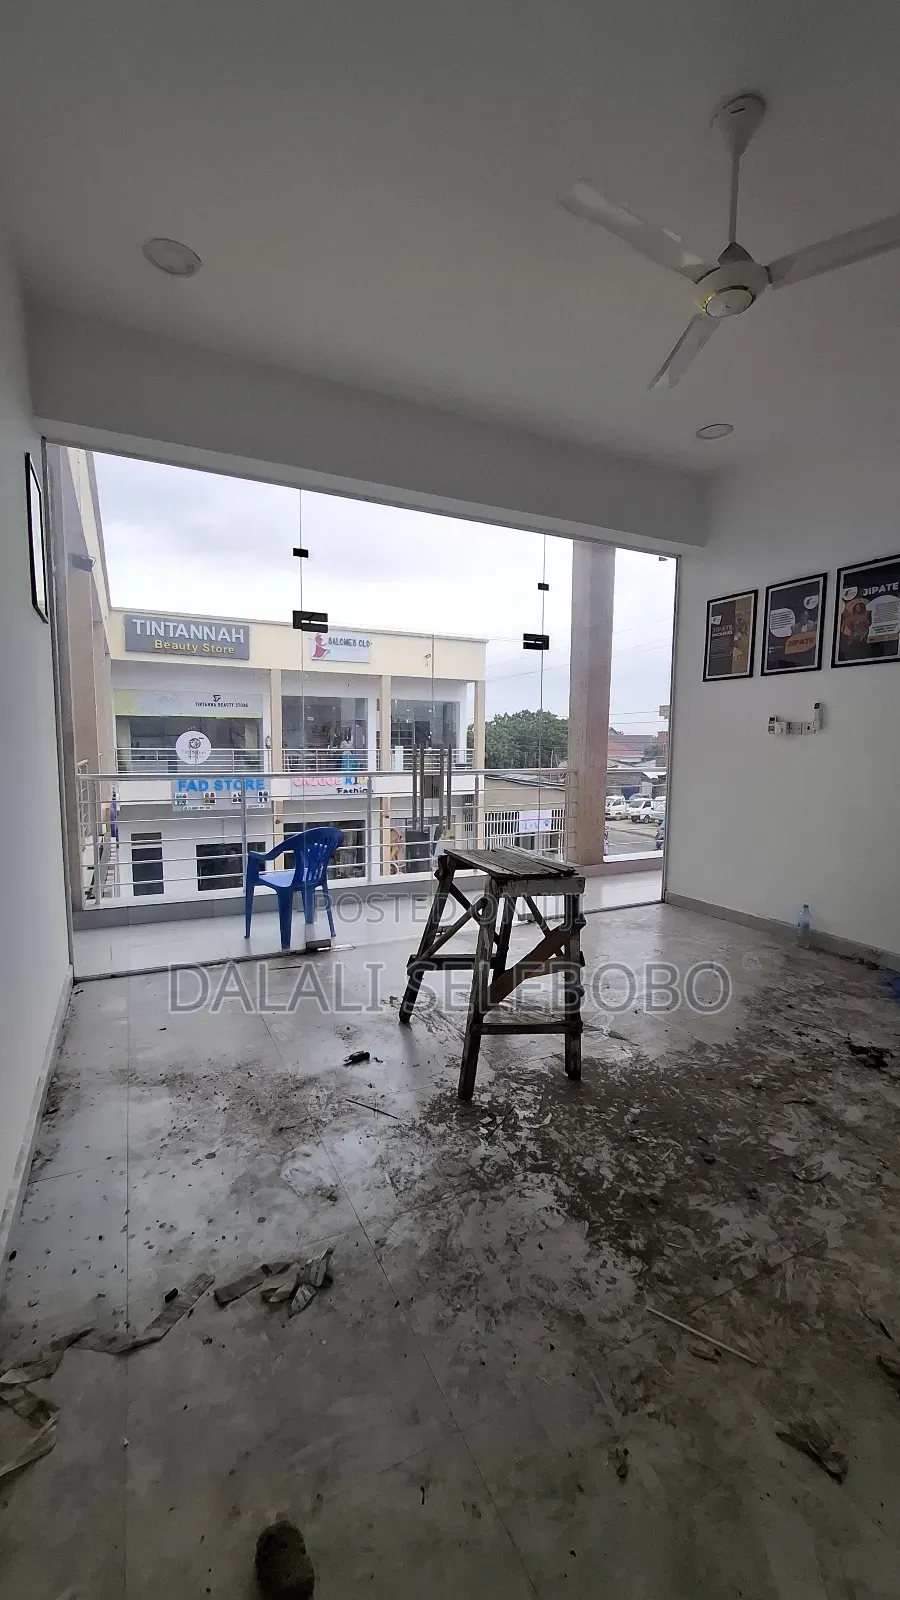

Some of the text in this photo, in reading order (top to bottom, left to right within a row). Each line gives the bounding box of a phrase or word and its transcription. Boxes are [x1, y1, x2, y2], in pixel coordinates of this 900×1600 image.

[862, 581, 900, 597] JIPATE
[131, 618, 245, 643] TINTANNAH
[154, 639, 235, 654] Beauty Store
[177, 778, 265, 792] FAD STORE
